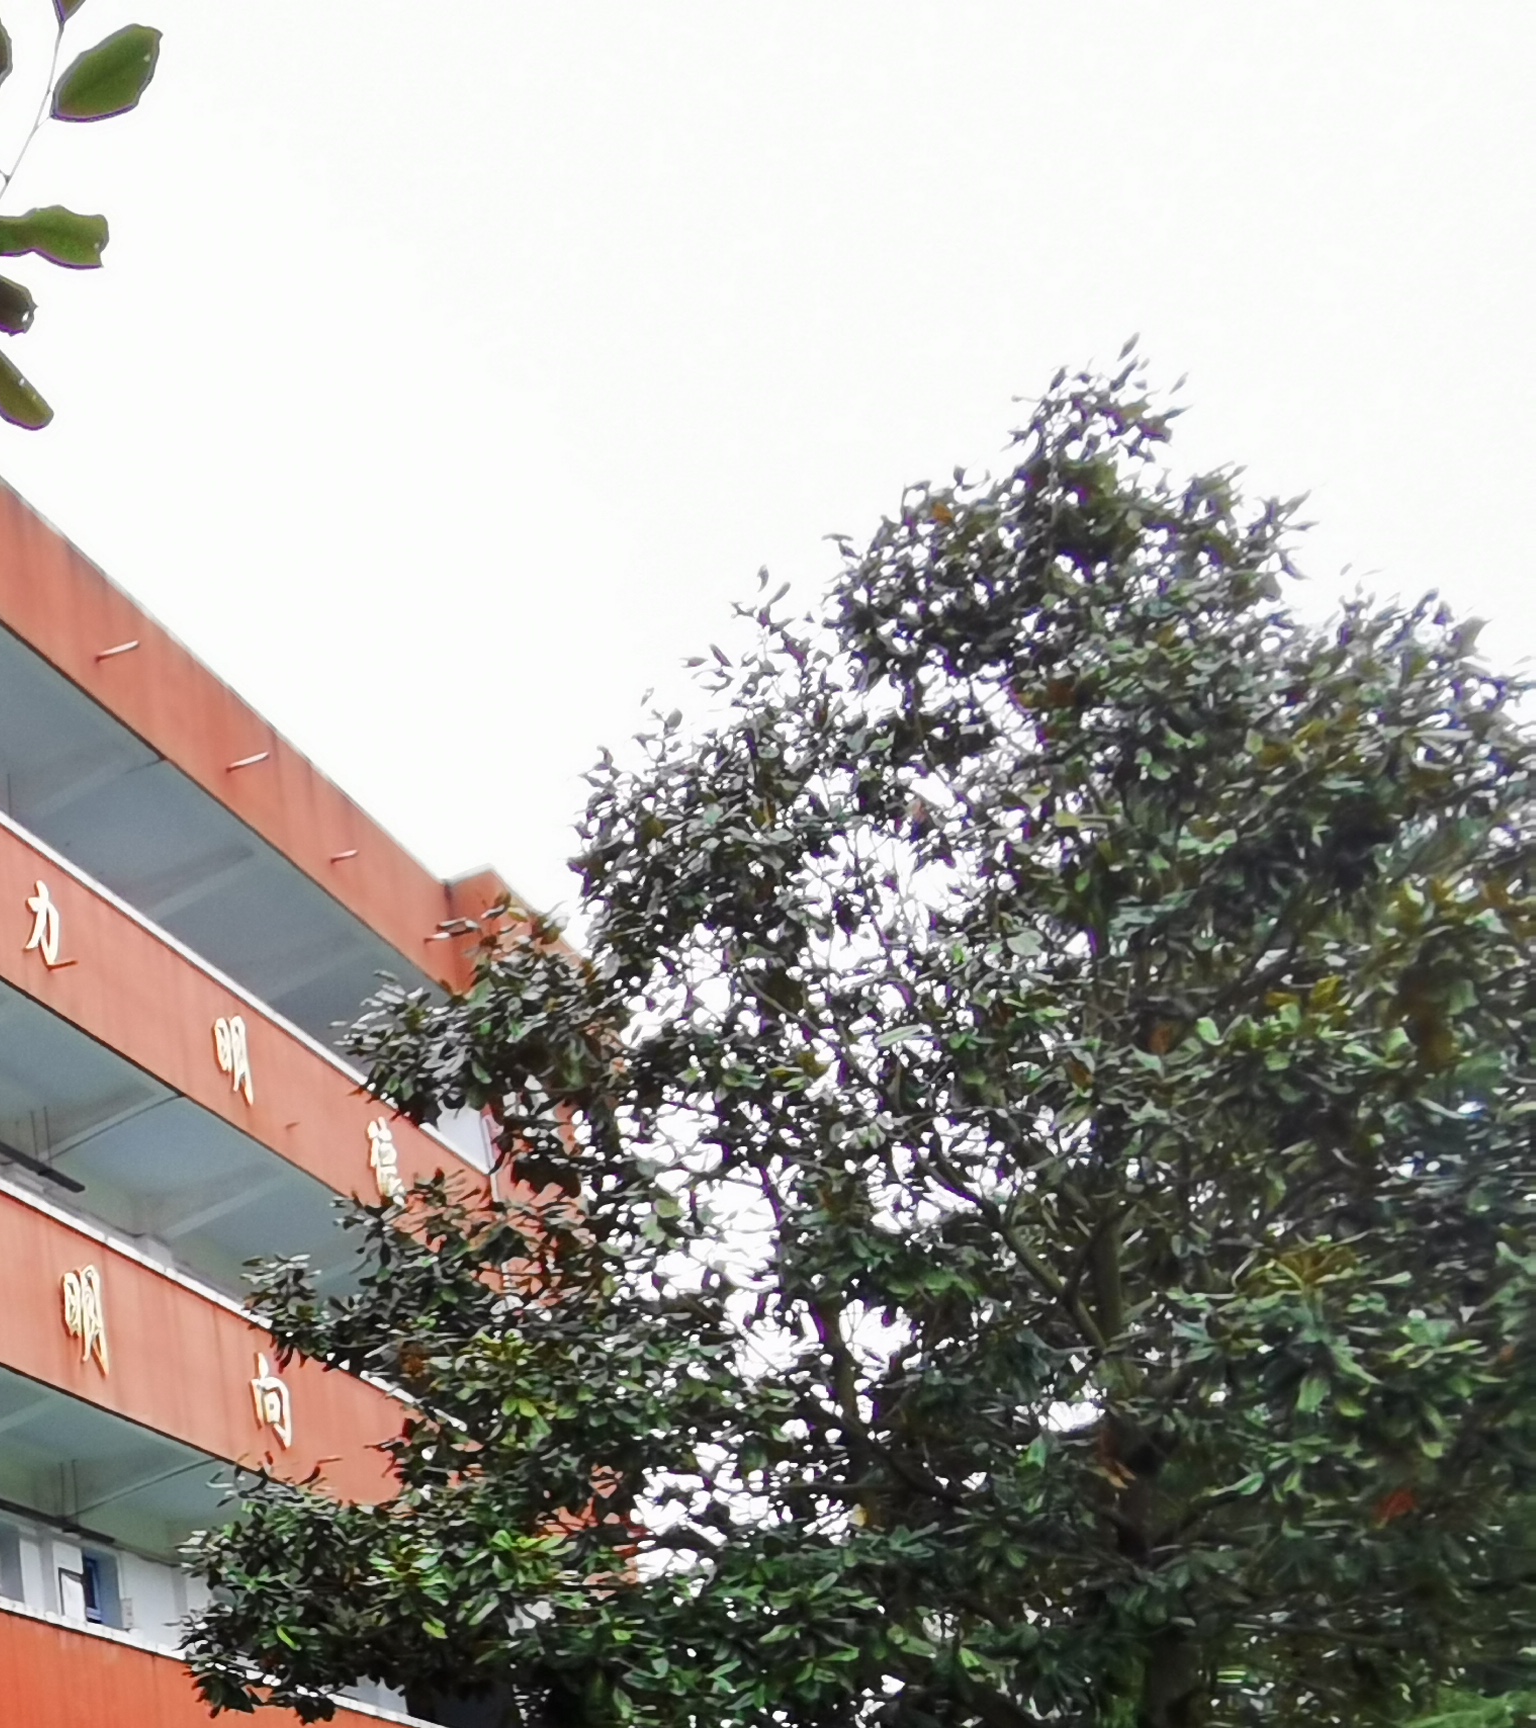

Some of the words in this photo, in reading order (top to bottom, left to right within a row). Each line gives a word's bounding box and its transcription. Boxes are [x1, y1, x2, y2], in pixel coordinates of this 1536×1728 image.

[26, 879, 60, 965] 力
[214, 1014, 254, 1106] 明
[62, 1264, 110, 1378] 明
[250, 1351, 293, 1449] 向
